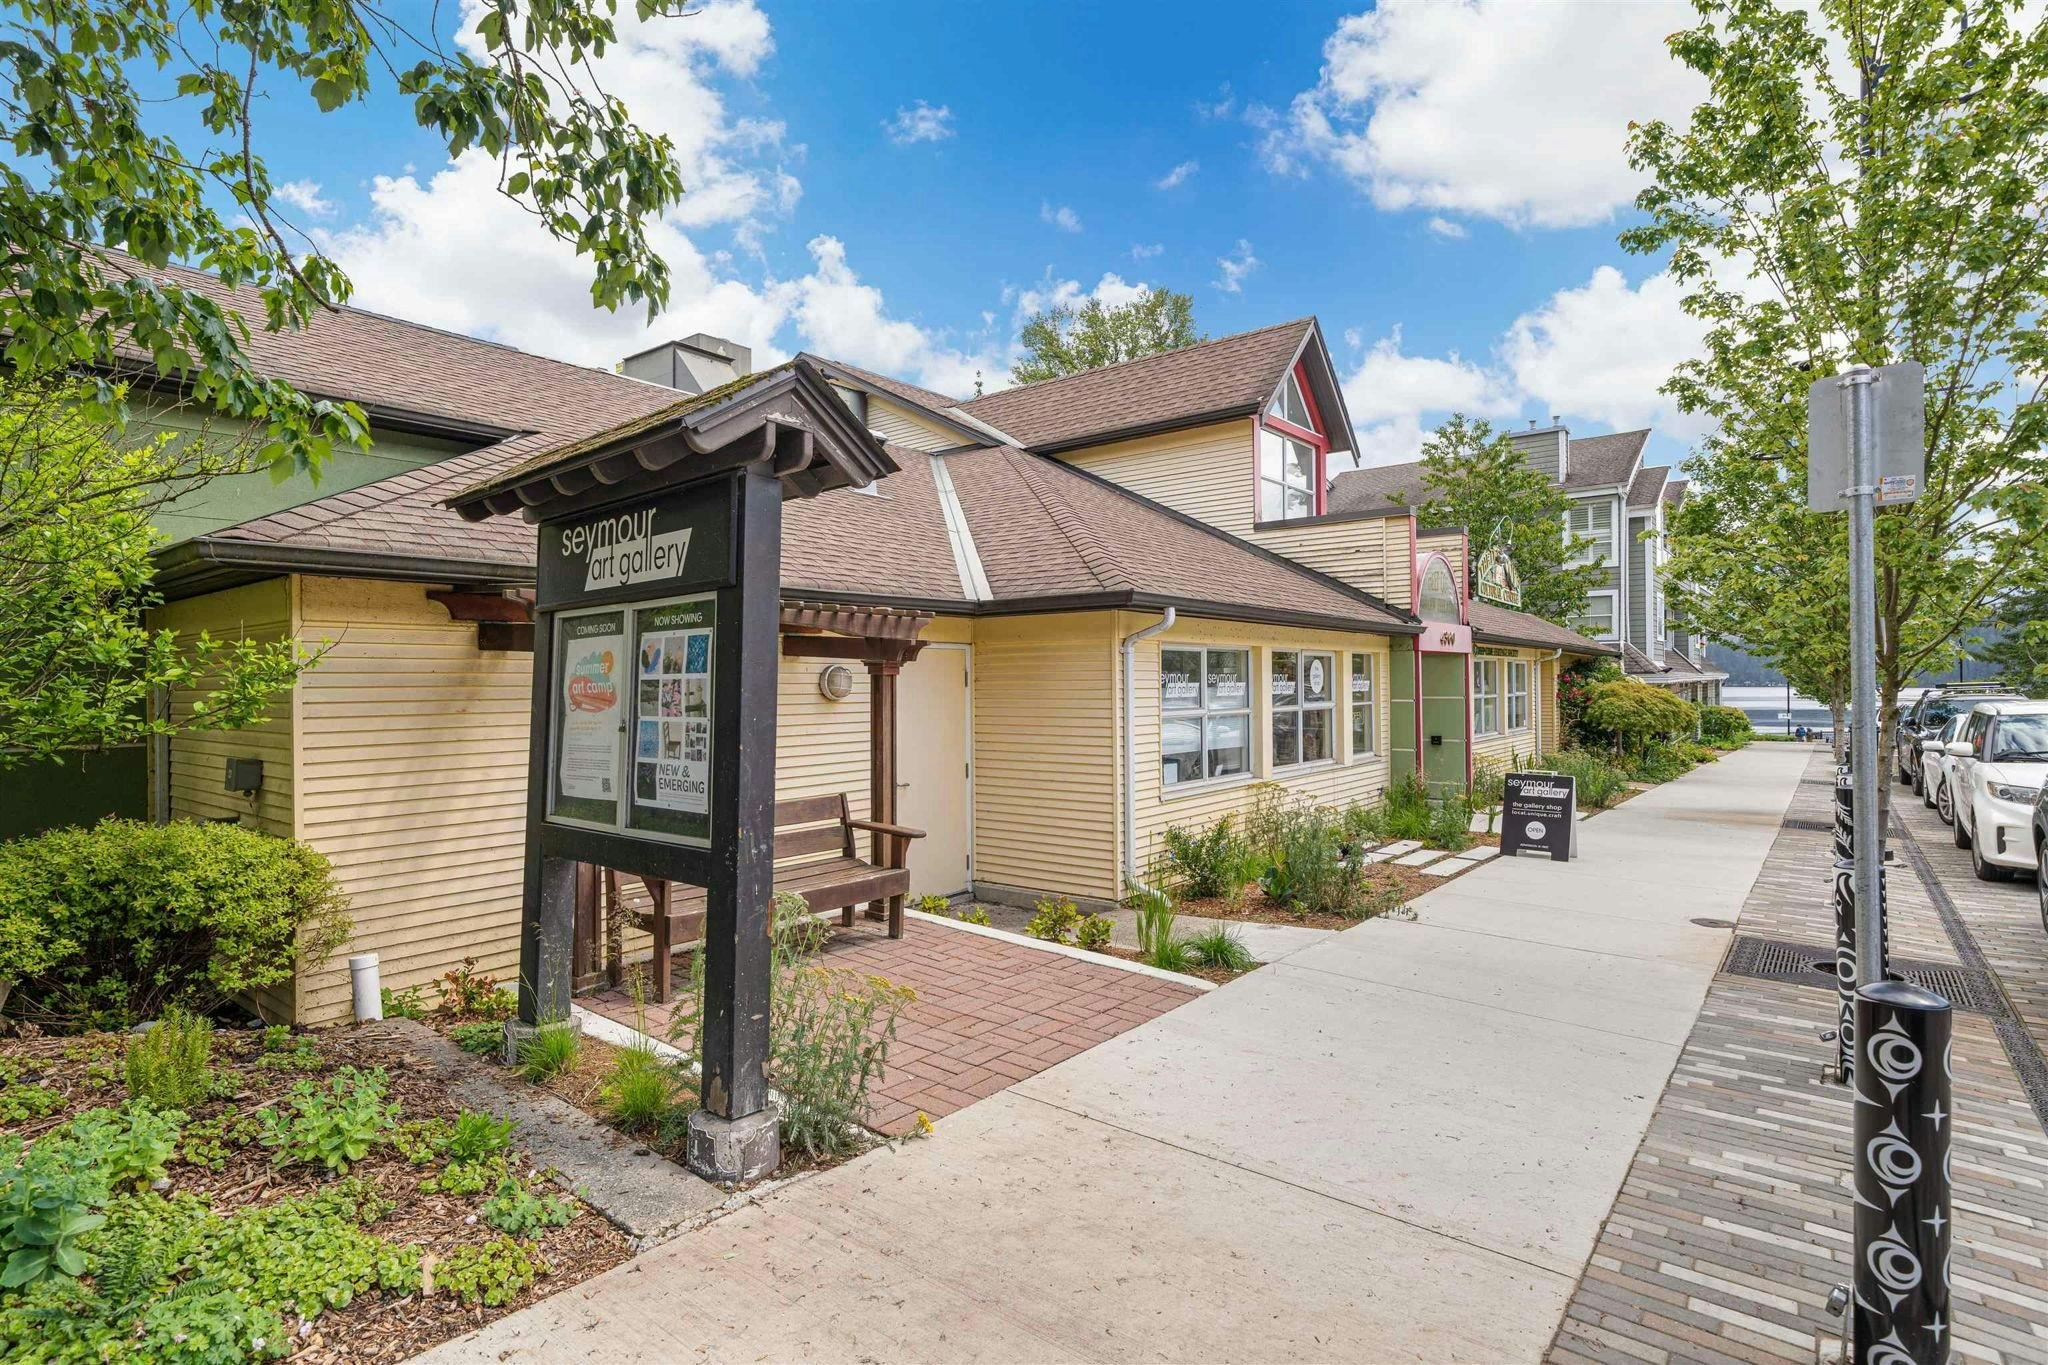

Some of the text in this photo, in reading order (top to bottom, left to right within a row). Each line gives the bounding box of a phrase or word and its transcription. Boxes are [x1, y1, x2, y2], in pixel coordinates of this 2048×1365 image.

[562, 507, 657, 563] seymour
[591, 540, 686, 586] art gallery
[654, 612, 703, 627] NOW SHOWING
[576, 622, 616, 635] COMING SOON
[576, 663, 609, 676] summer
[1161, 673, 1190, 687] eymour
[1207, 673, 1238, 687] seymour
[572, 680, 613, 696] art camp
[1177, 685, 1199, 697] gallery
[658, 763, 691, 778] NEW &
[658, 777, 705, 794] EMERGING
[1507, 778, 1555, 789] seymour
[1537, 788, 1567, 798] gallery
